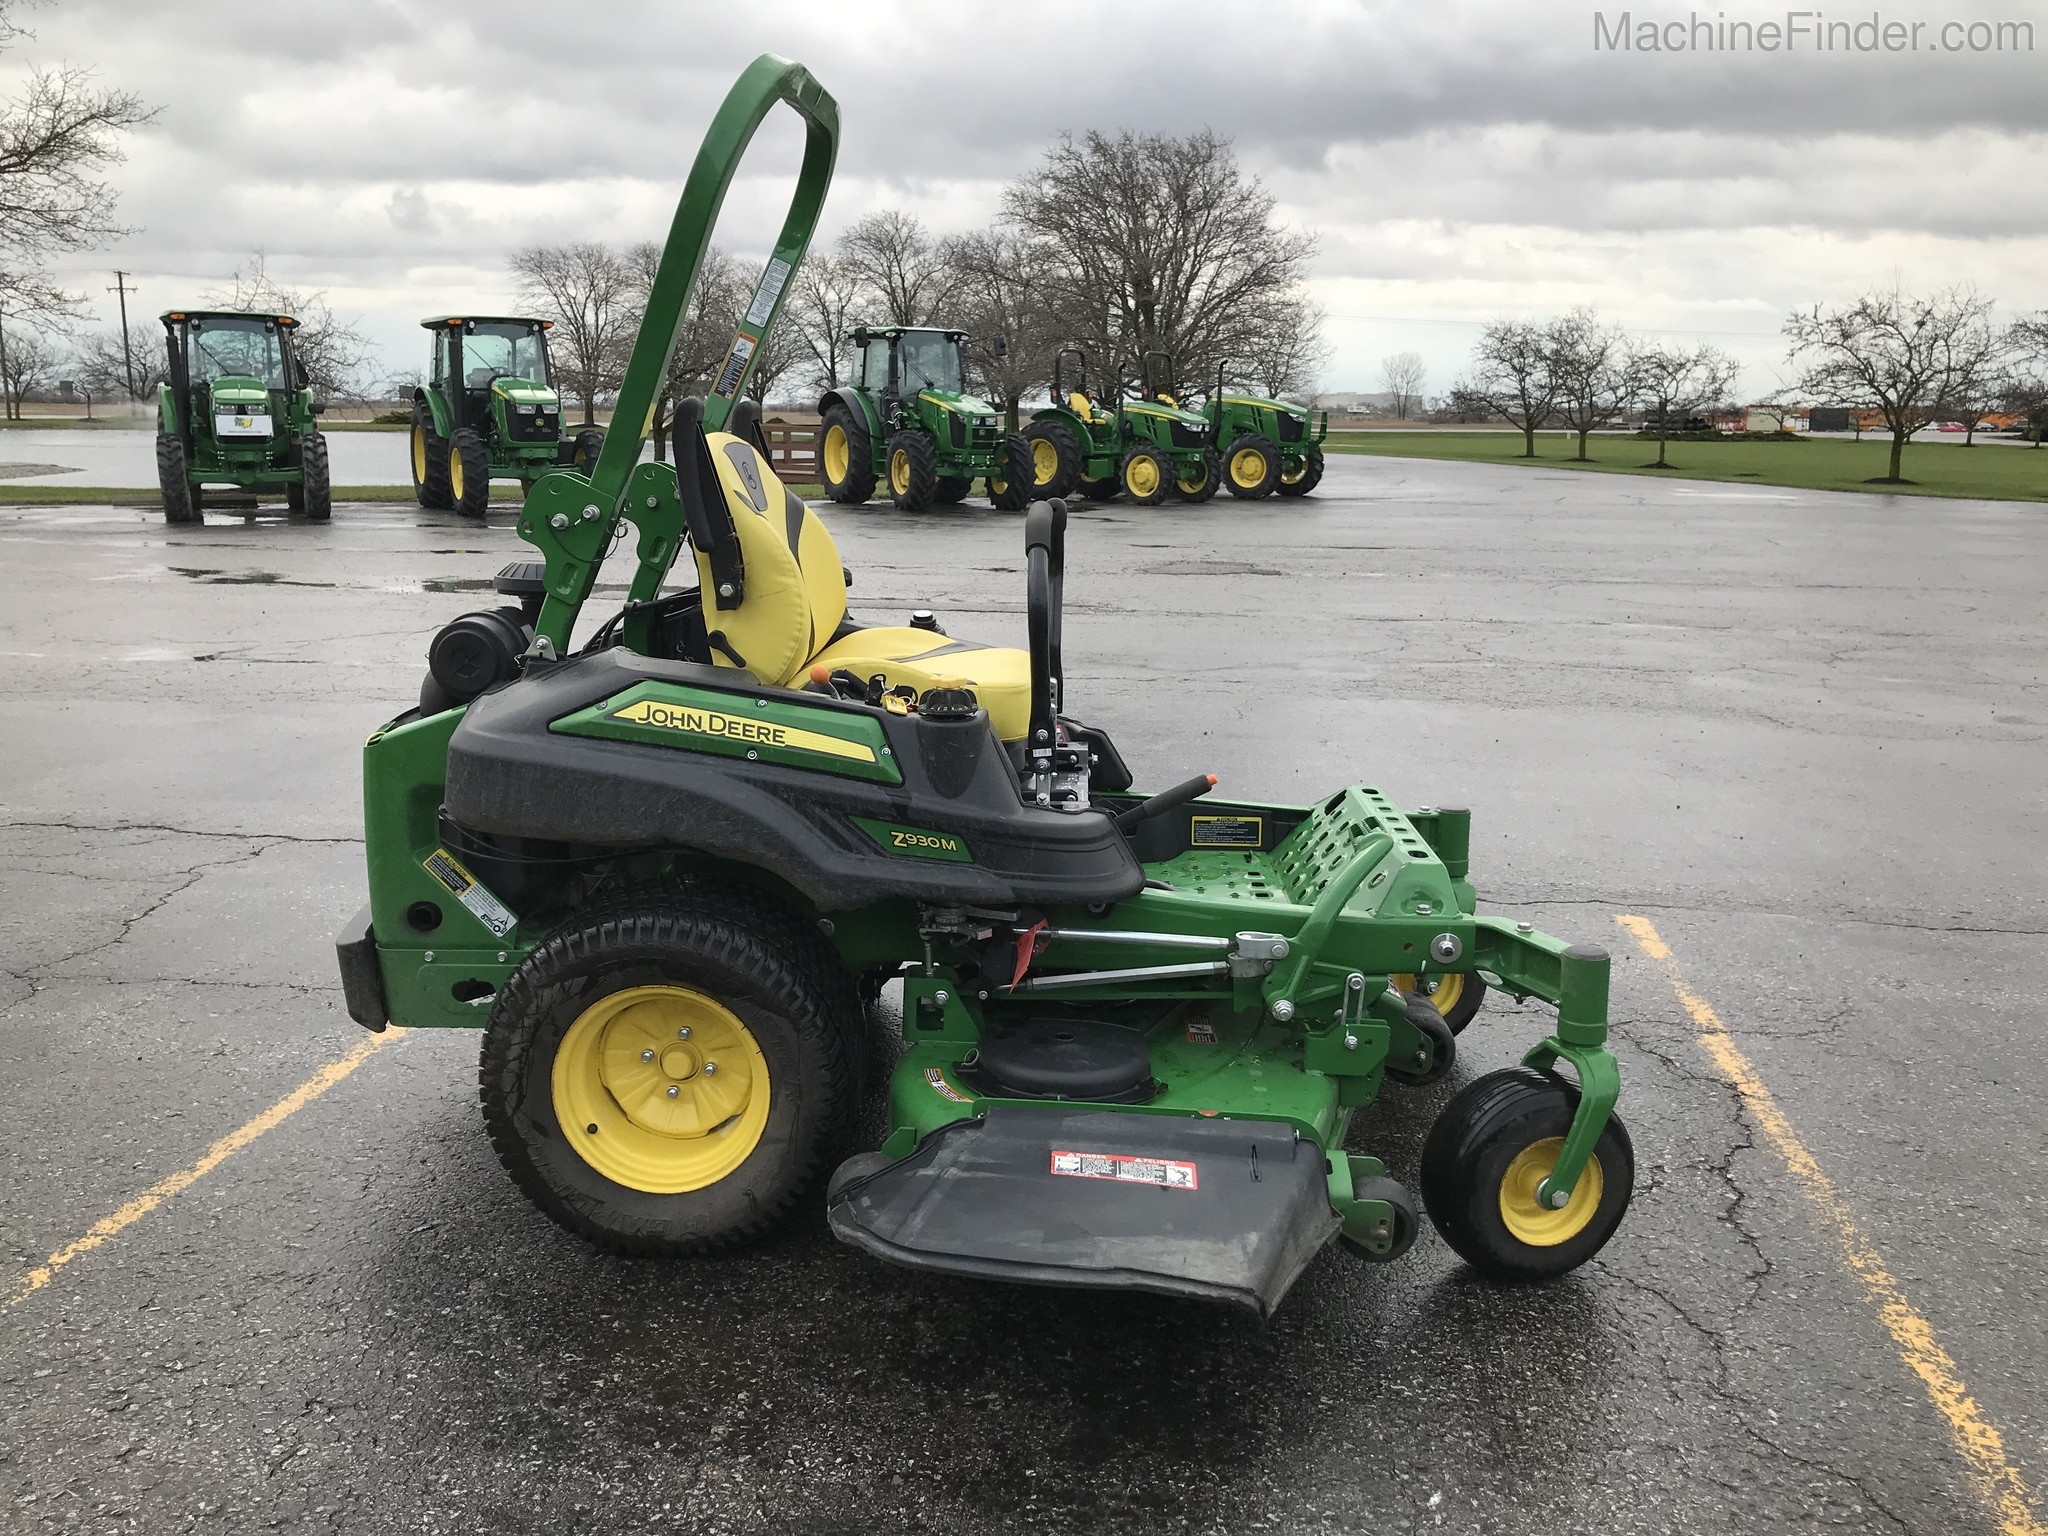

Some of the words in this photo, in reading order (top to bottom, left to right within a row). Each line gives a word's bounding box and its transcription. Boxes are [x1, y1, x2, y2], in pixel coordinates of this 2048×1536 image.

[638, 704, 702, 730] JOHN
[708, 714, 786, 744] DEERE
[1143, 1158, 1175, 1166] PELIGRO
